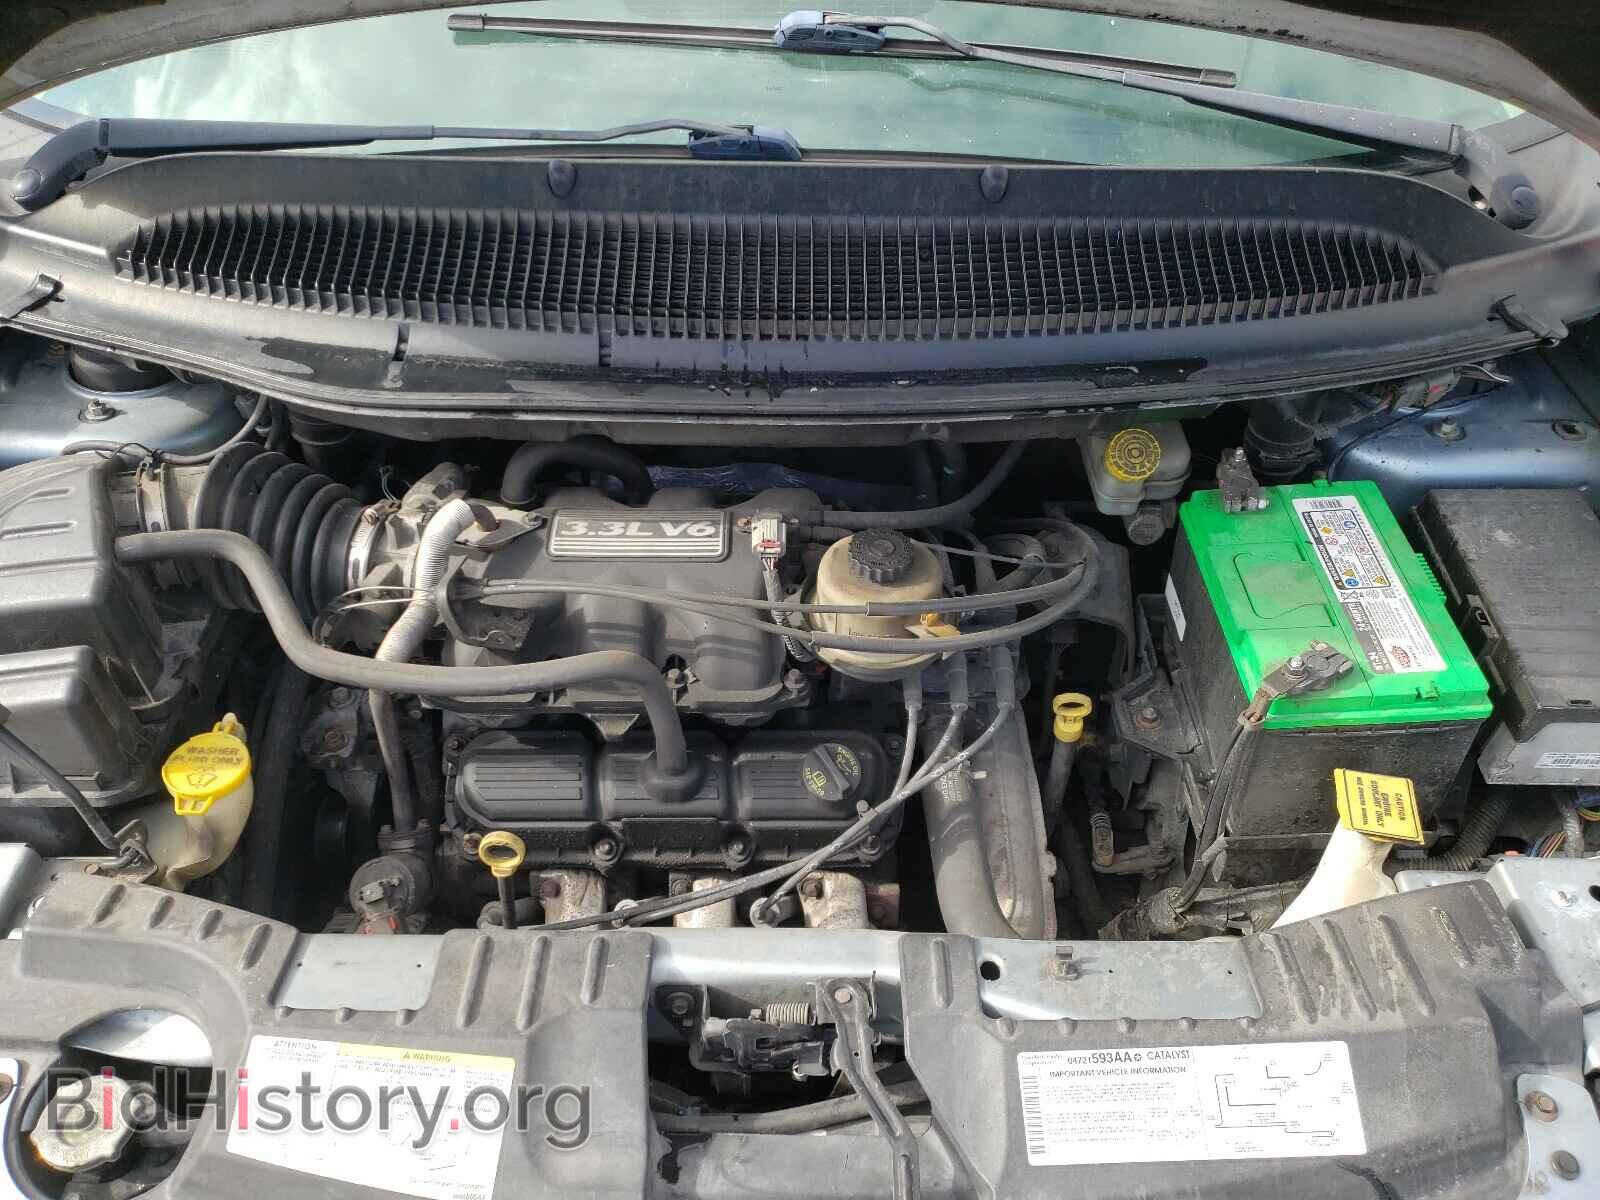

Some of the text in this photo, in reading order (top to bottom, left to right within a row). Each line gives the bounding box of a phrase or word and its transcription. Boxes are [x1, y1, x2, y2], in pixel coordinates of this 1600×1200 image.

[561, 521, 716, 537] 3.3L V6
[187, 746, 240, 755] WASHER
[1370, 780, 1385, 828] COOLANT ONLY
[1394, 792, 1406, 821] CAUTION
[414, 1053, 452, 1063] WARNING
[1146, 1049, 1190, 1061] CATALYST
[1050, 1066, 1186, 1078] IMPORTANT VEHICLE INFORMATION
